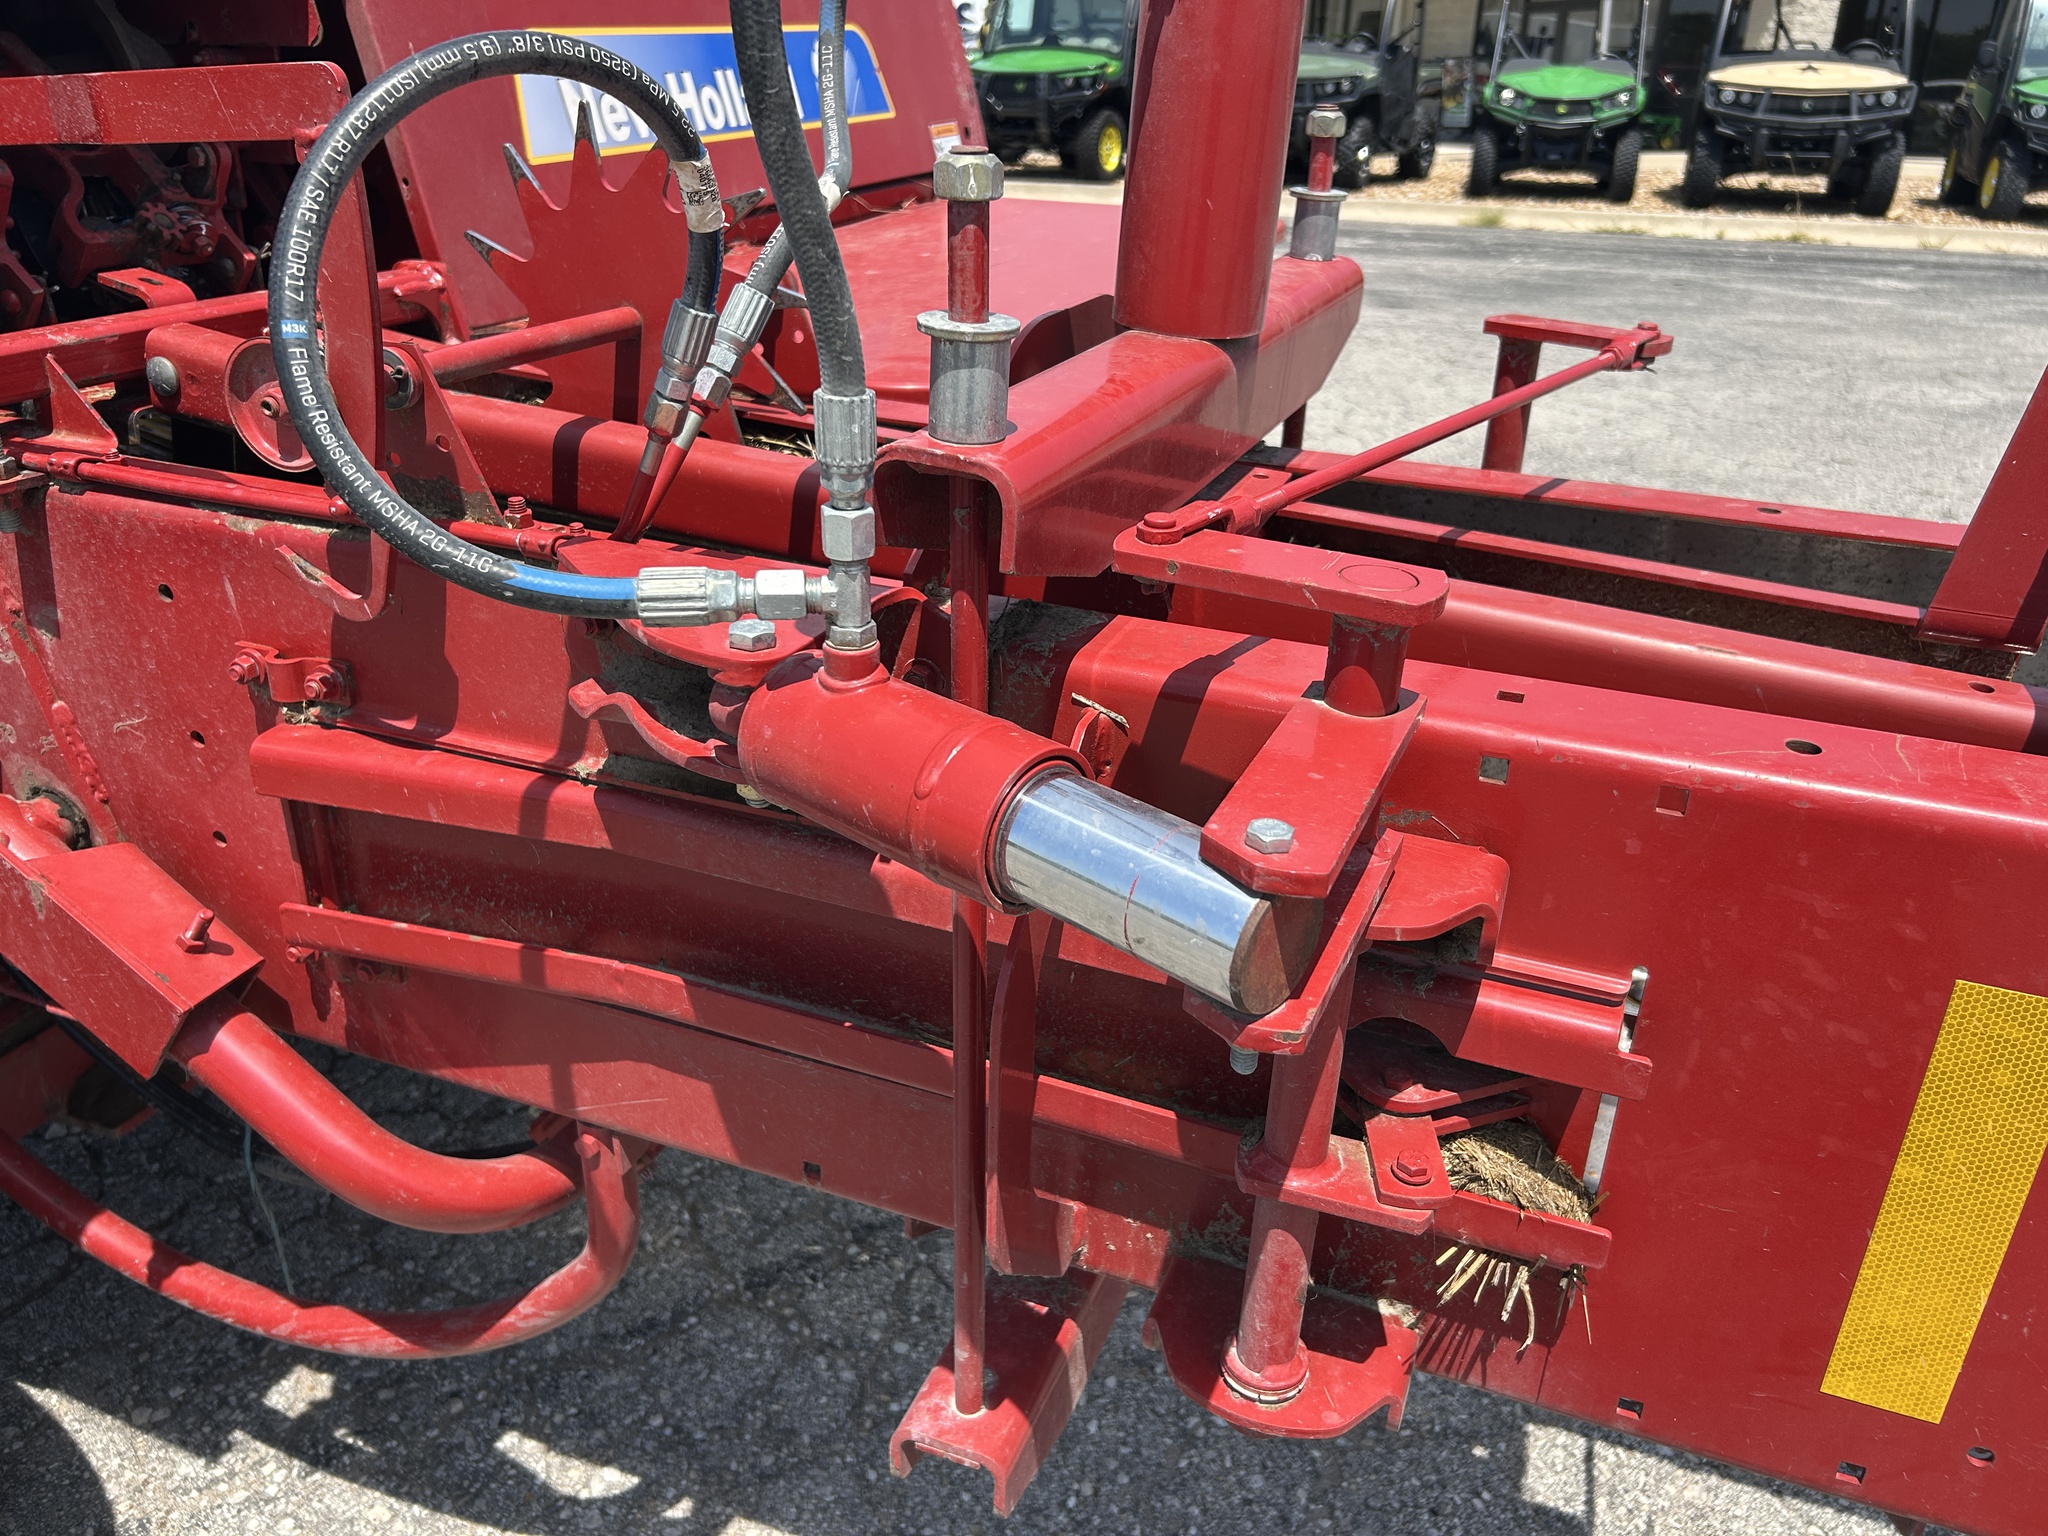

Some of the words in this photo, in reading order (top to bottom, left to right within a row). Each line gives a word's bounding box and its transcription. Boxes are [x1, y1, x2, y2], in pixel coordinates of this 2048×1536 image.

[463, 35, 501, 60] (9.5
[550, 34, 585, 59] PSI)
[590, 47, 637, 80] (3250
[641, 72, 670, 106] MPa
[664, 65, 805, 131] Holl
[823, 89, 836, 118] MSHA
[297, 186, 325, 226] SAE
[284, 224, 312, 302] 100R17
[281, 323, 308, 335] M3K
[288, 347, 317, 406] Flame
[308, 407, 372, 494] Resistant
[368, 489, 421, 537] MSHA
[418, 528, 494, 574] 2G-11C
